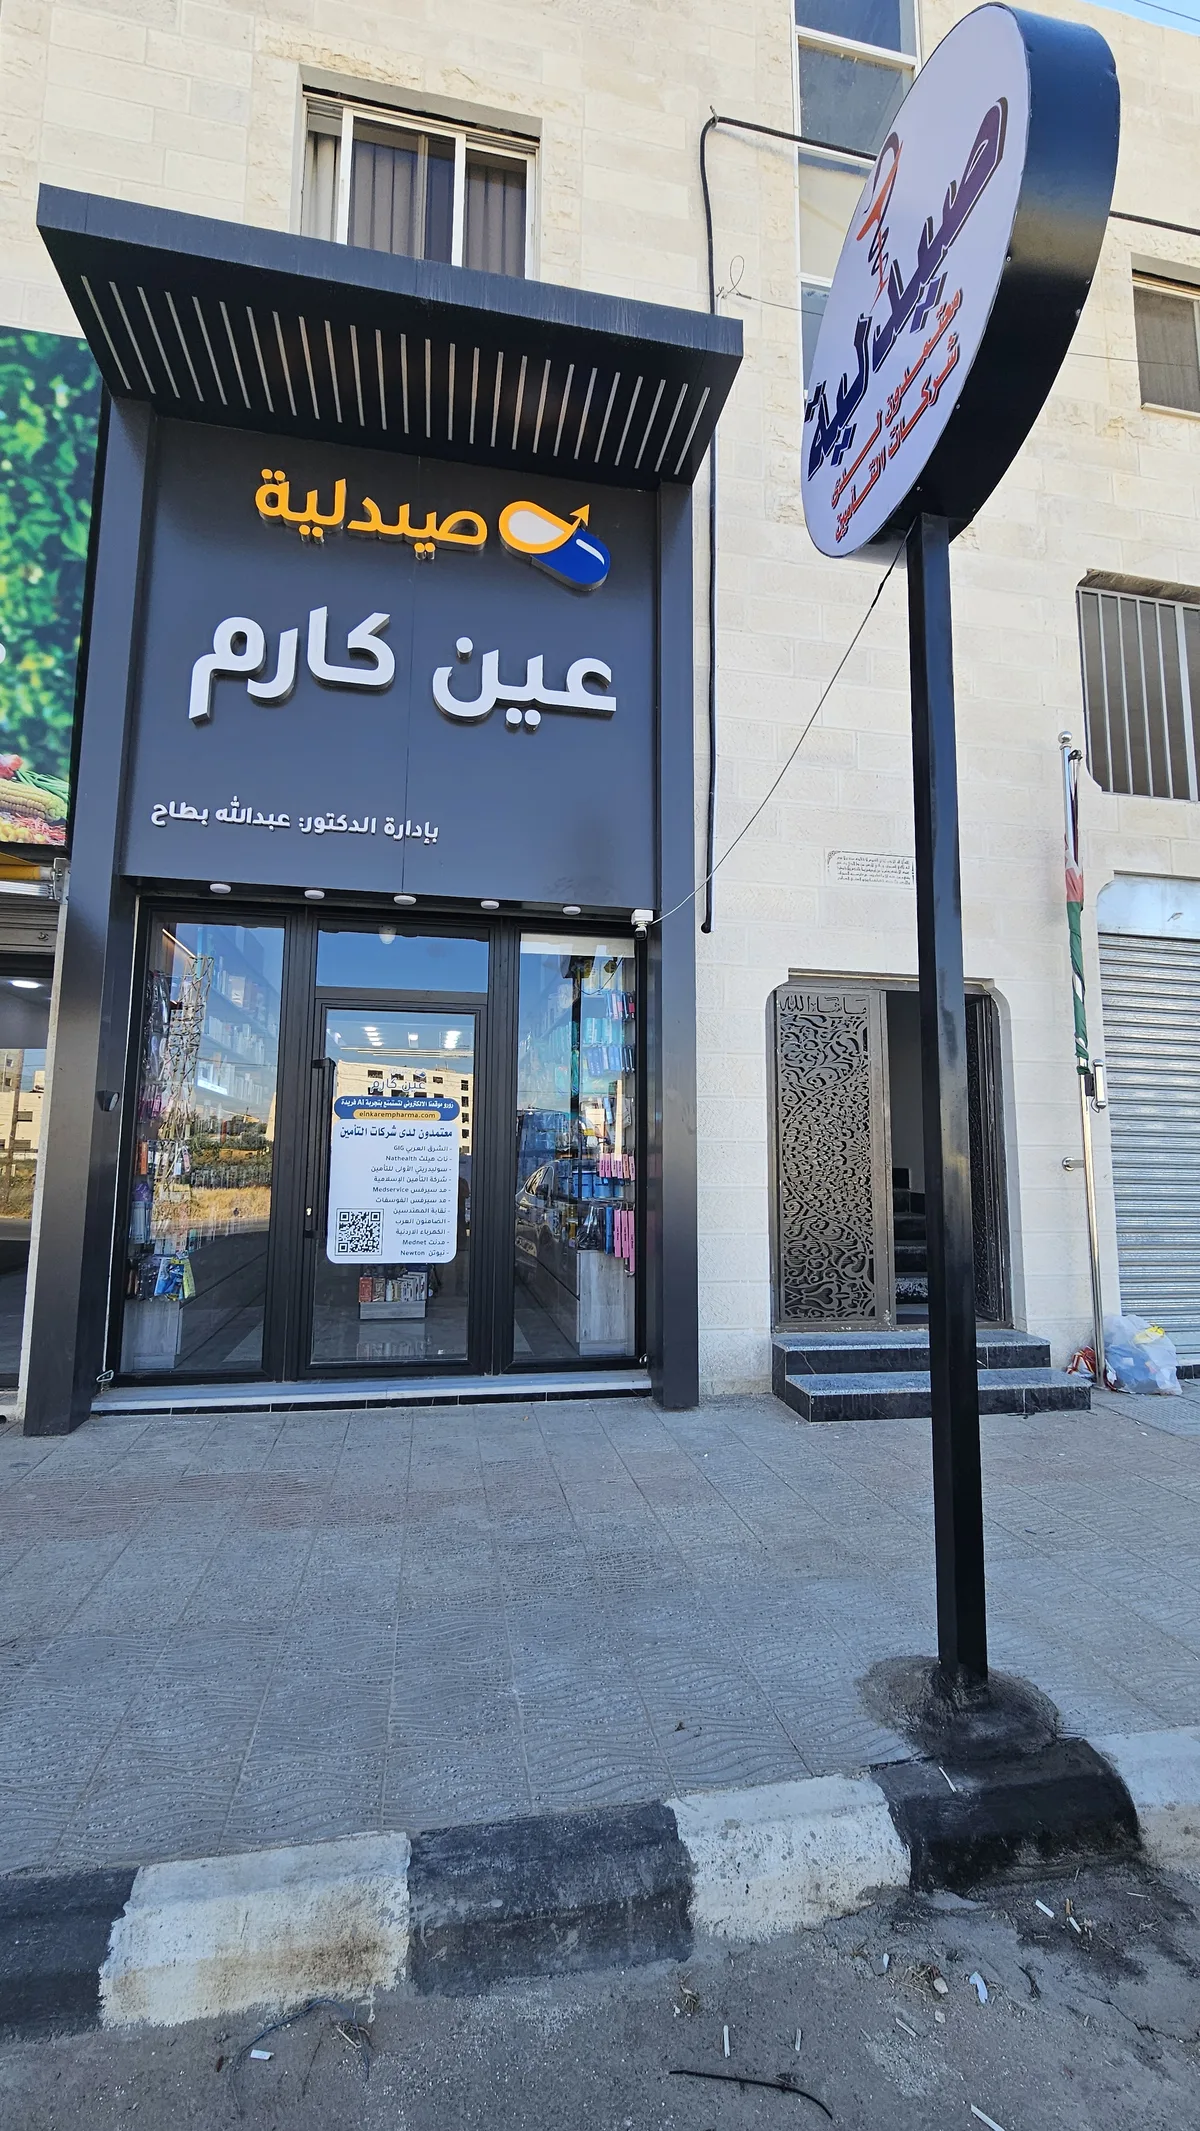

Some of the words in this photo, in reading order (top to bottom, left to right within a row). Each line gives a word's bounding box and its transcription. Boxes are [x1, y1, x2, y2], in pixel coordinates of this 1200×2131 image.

[804, 97, 1008, 481] صيدلية
[884, 287, 962, 426] معتمدون
[886, 332, 960, 459] شركات
[831, 407, 884, 509] لدى
[255, 469, 488, 559] صيدلية
[189, 605, 396, 724] كارم
[433, 636, 617, 730] عين
[151, 801, 209, 827] بطاح
[215, 795, 290, 829] عبدالله
[299, 815, 376, 836] الدكتور:
[384, 816, 439, 843] بإدارة
[780, 995, 810, 1012] الله
[370, 1078, 397, 1093] كارم
[402, 1079, 426, 1092] عين
[341, 1098, 356, 1107] فريدة
[340, 1124, 367, 1138] التأمين
[370, 1125, 396, 1139] شركات
[399, 1128, 415, 1138] لدى
[418, 1128, 452, 1139] معتمدون
[406, 1175, 428, 1183] التأمين
